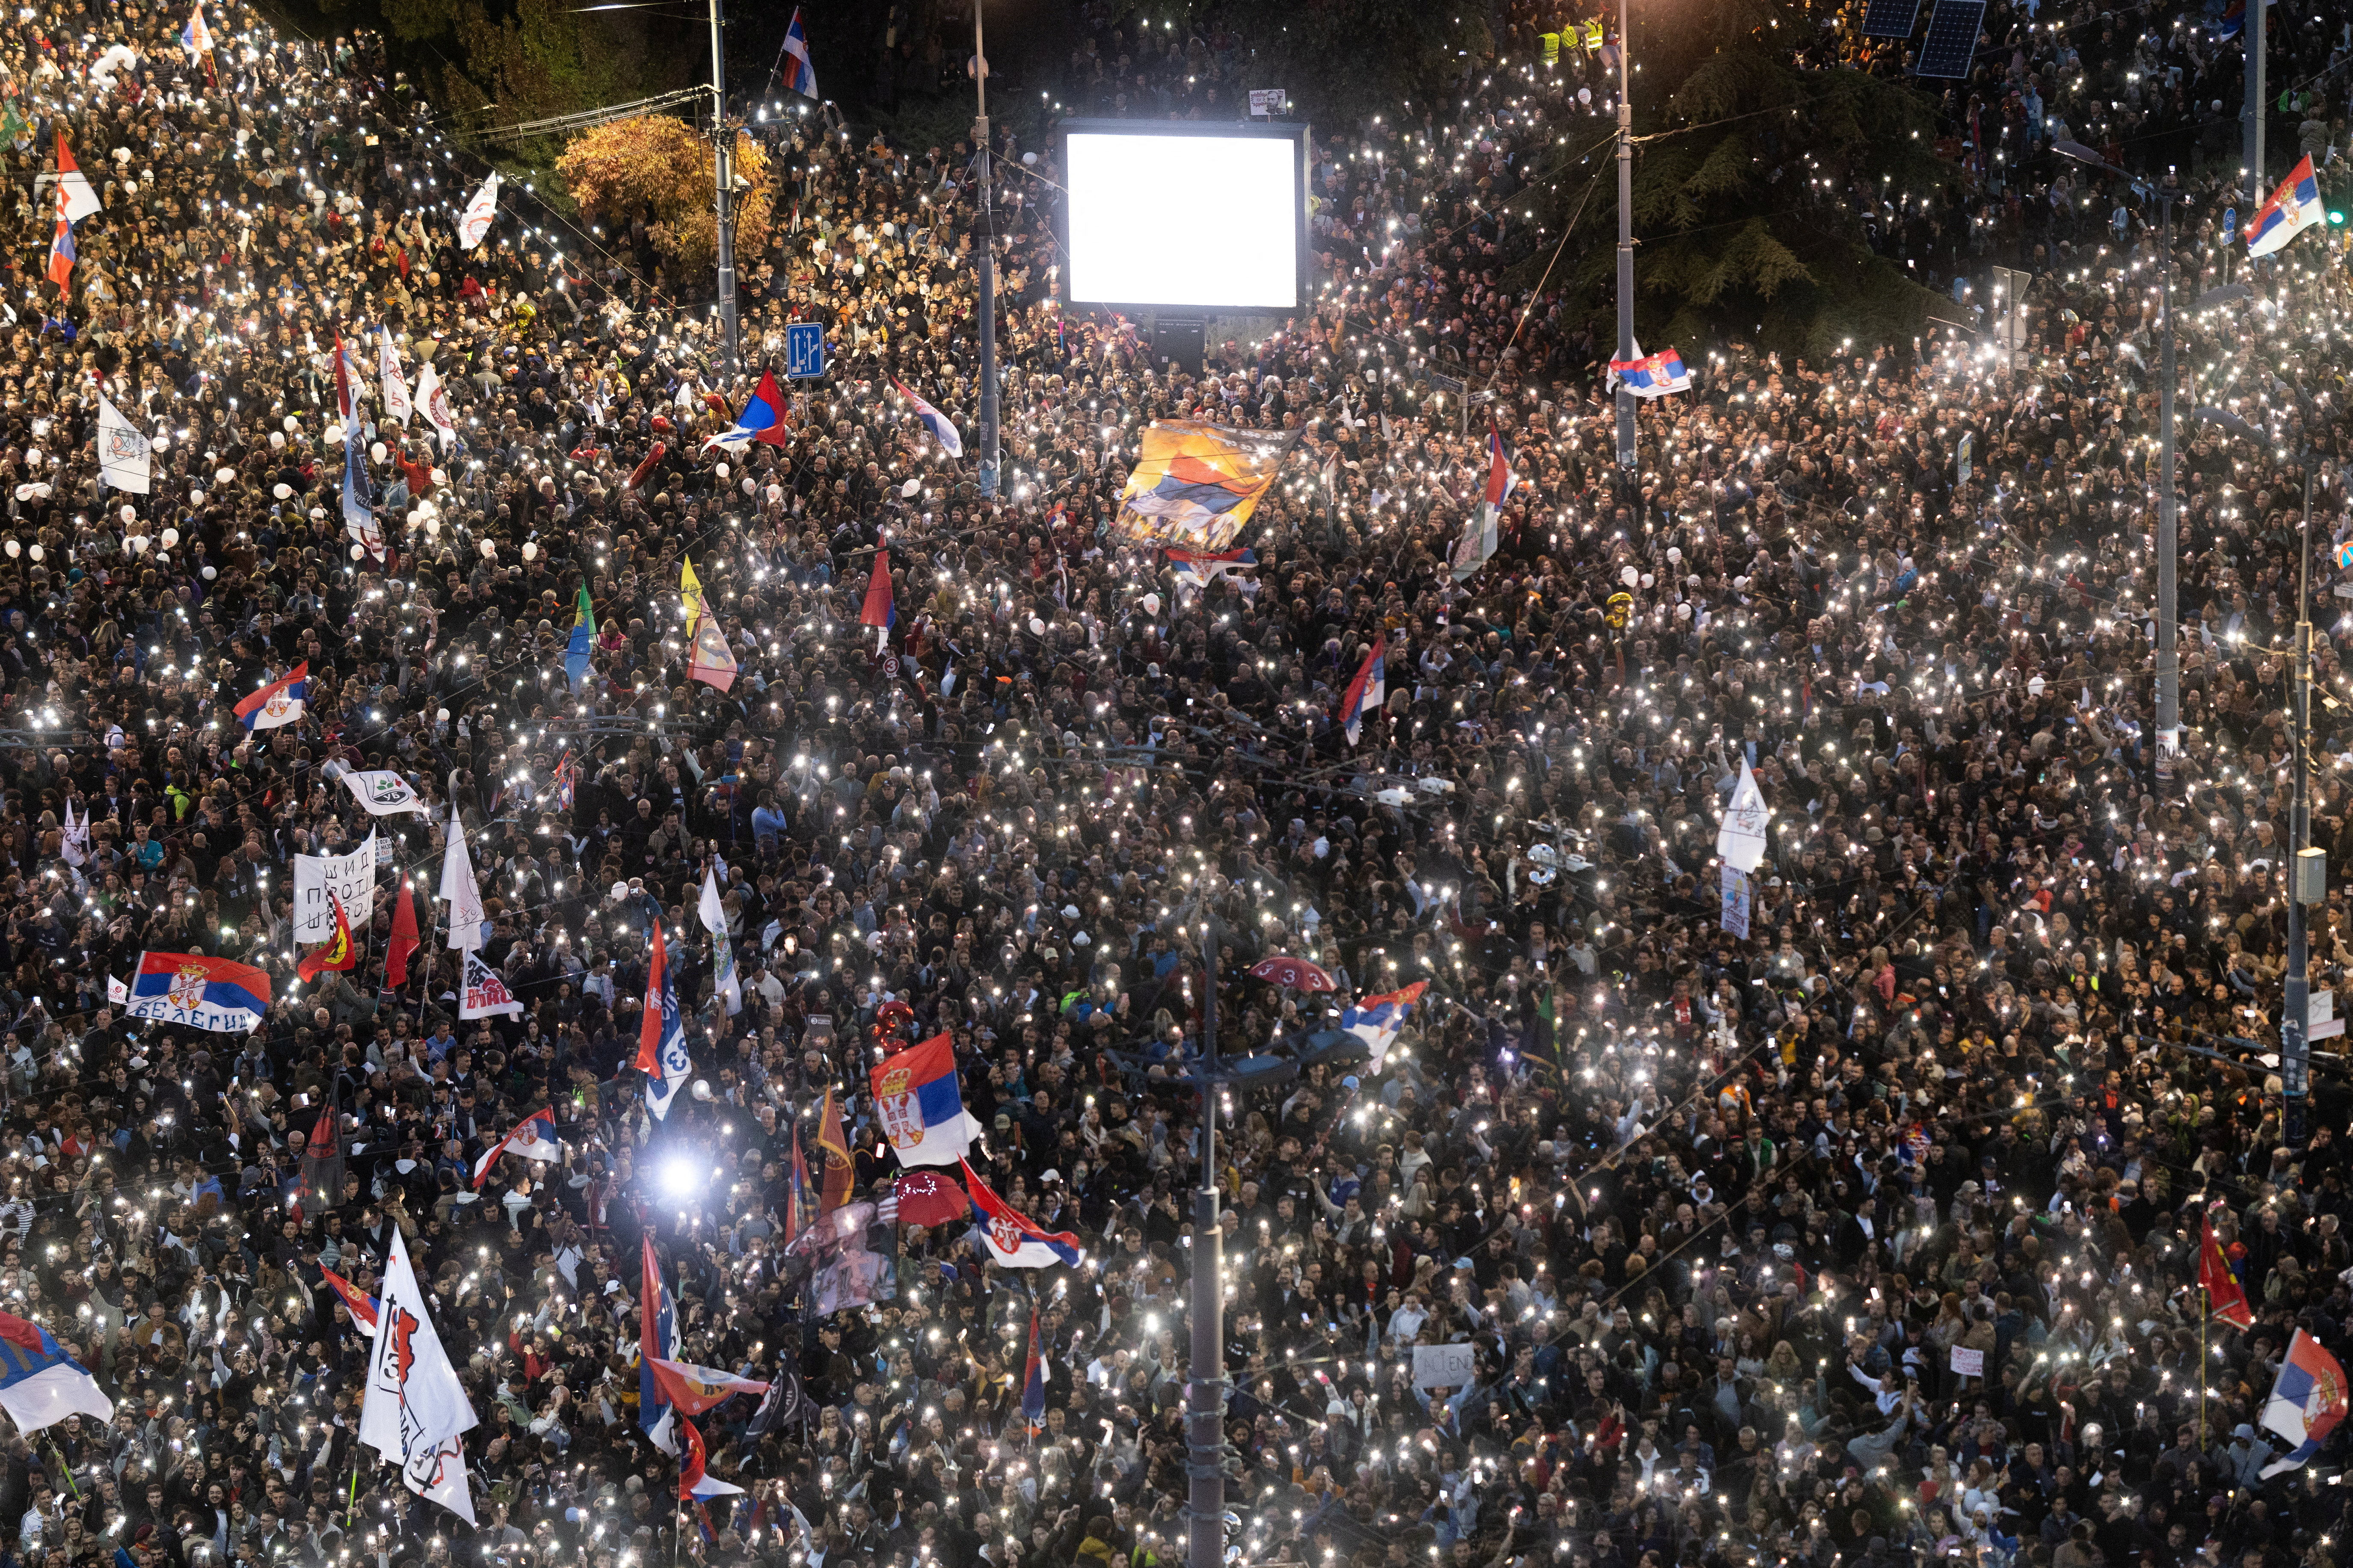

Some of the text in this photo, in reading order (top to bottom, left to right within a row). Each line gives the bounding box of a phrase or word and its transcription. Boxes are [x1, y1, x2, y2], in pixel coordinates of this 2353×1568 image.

[887, 660, 895, 671] 3
[383, 792, 400, 801] УБ
[324, 851, 369, 879] ШИД
[1259, 964, 1274, 976] 3
[1283, 969, 1295, 983] 3
[1309, 973, 1322, 988] 3
